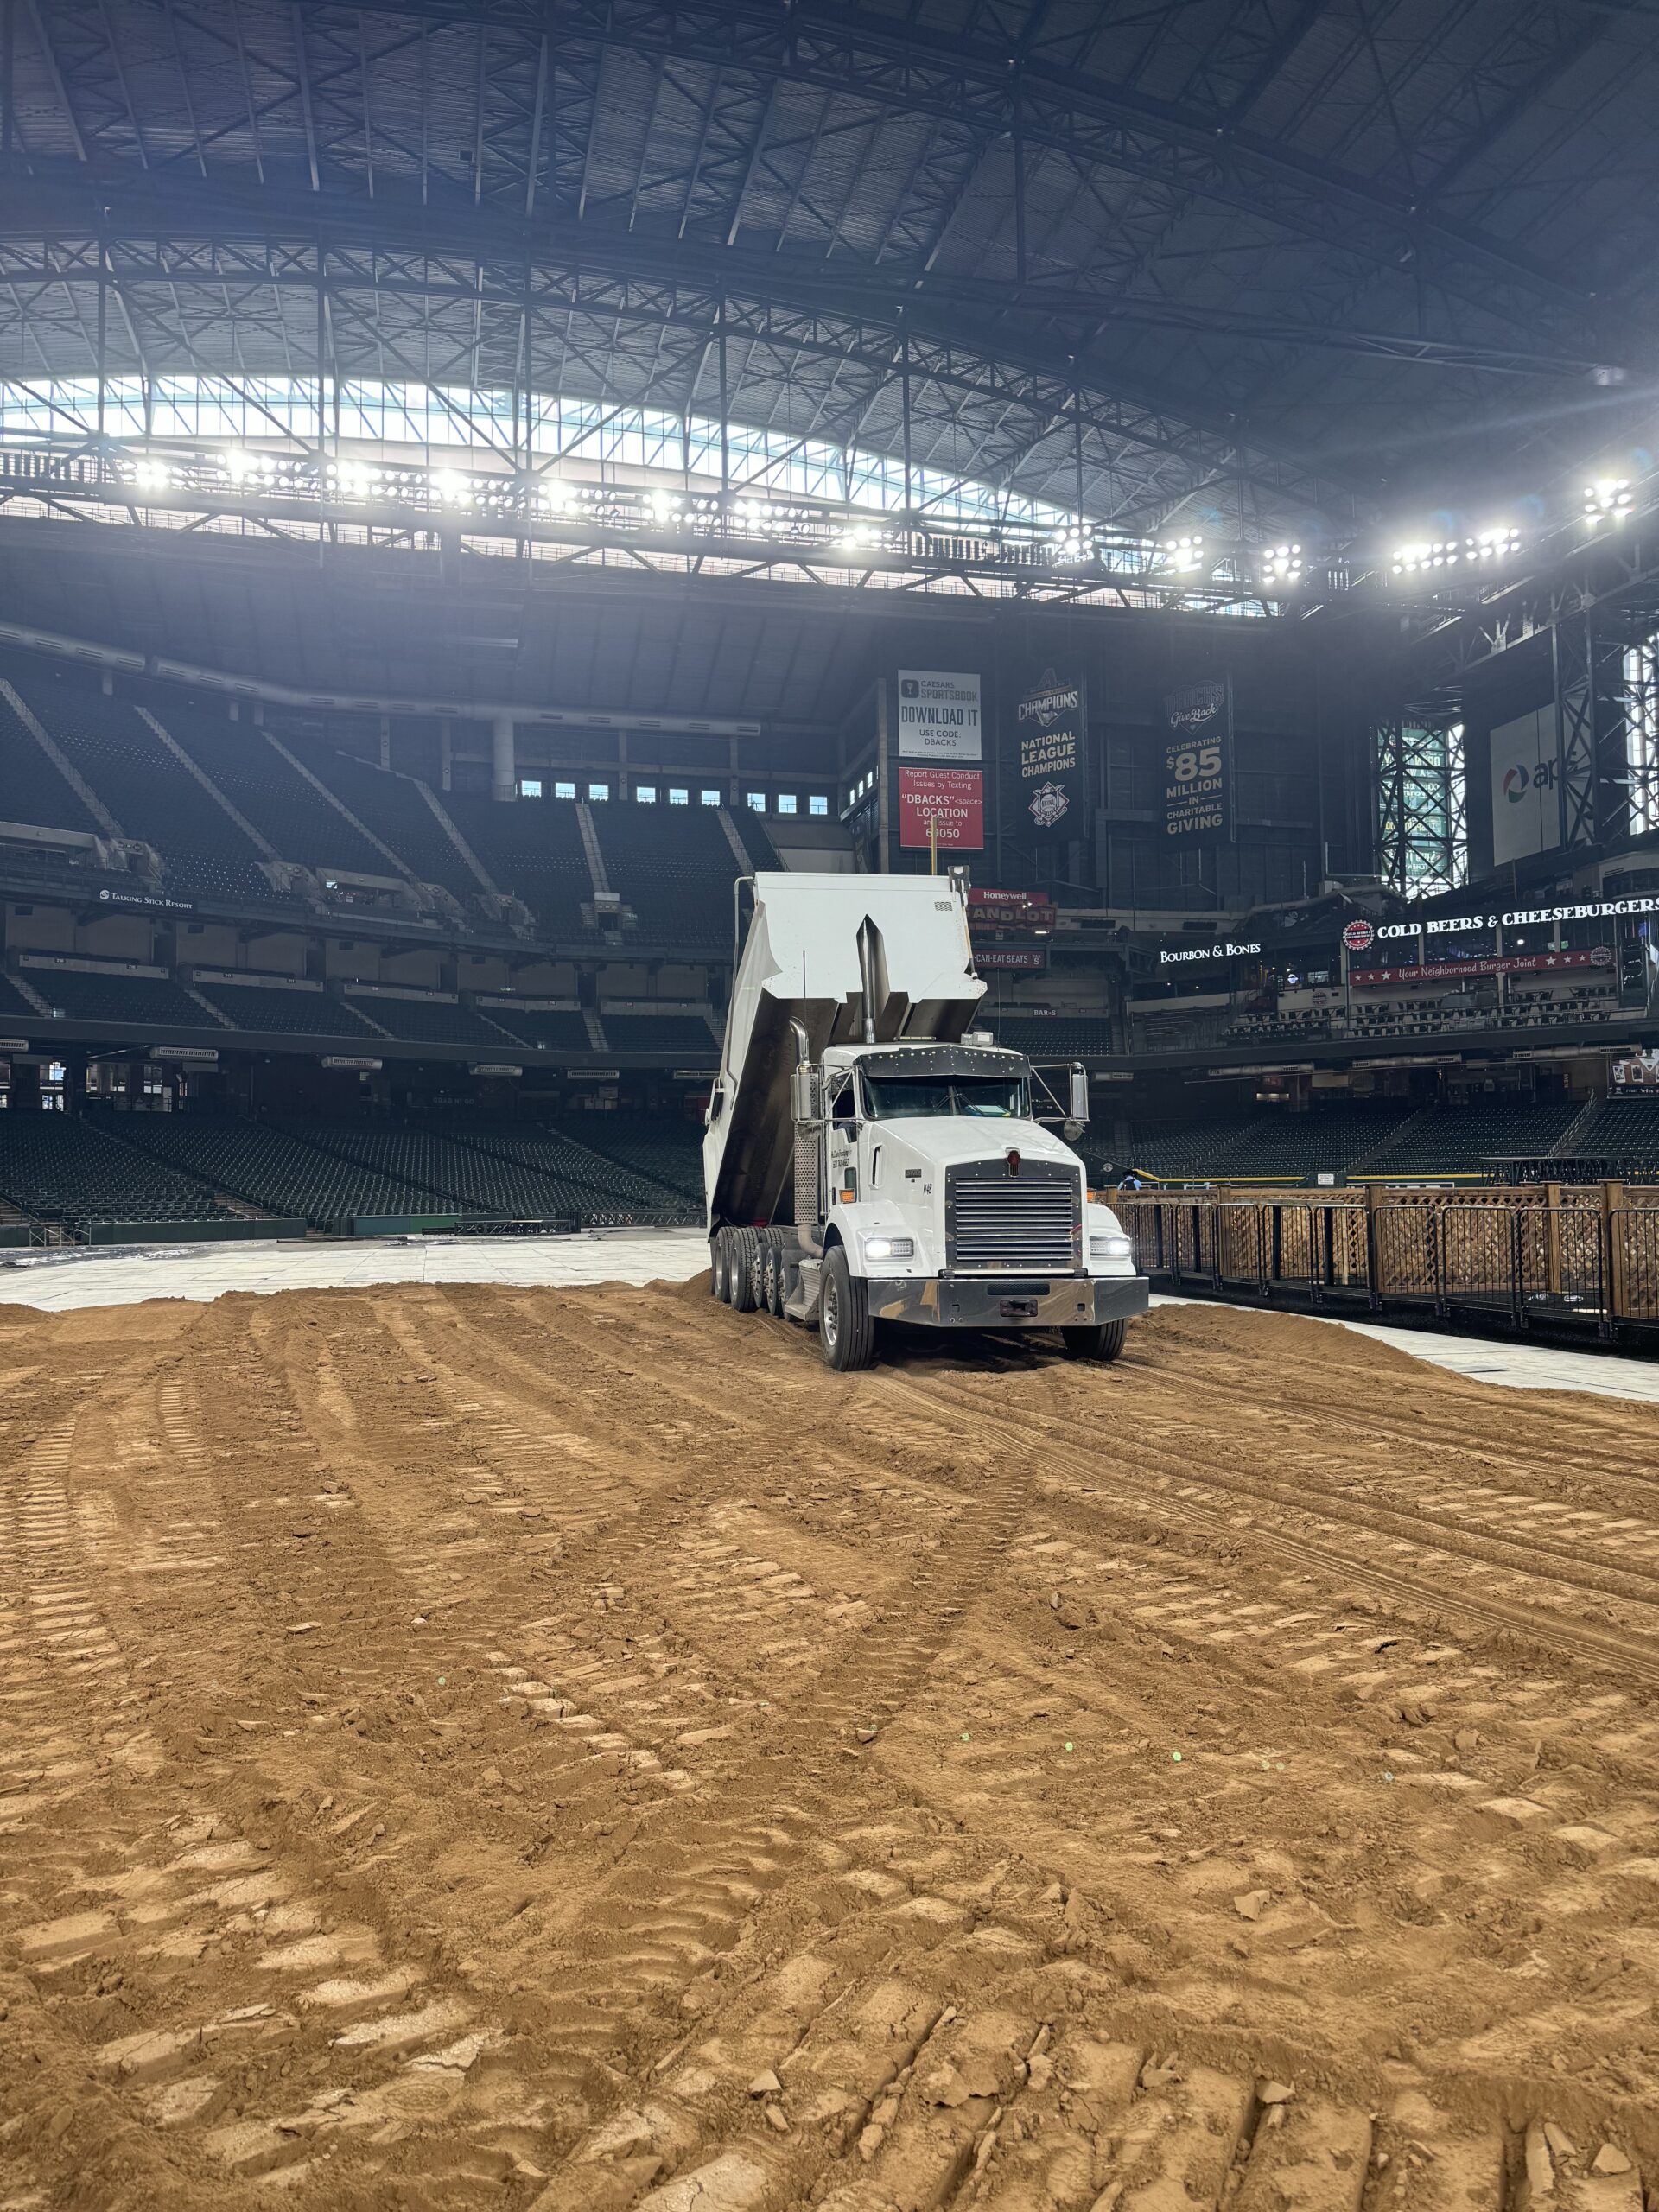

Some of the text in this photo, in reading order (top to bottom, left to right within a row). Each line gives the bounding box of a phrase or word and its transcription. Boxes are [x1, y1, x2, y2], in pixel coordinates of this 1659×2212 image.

[921, 680, 955, 689] CAESARS
[921, 689, 978, 702] SPORTSBOOK
[1019, 691, 1077, 720] CHAMPIONS
[1190, 703, 1217, 722] Back
[901, 706, 978, 726] DOWNLOAD IT
[925, 738, 957, 747] DBACKS
[1021, 731, 1076, 751] NATIONAL
[1166, 735, 1222, 753] CELEBRATING
[1021, 742, 1076, 765] LEAGUE
[1021, 757, 1076, 778] CHAMPIONS
[1166, 747, 1222, 781] $85
[905, 769, 927, 779] Report
[951, 772, 980, 780] Conduct
[937, 780, 945, 789] by
[947, 781, 972, 790] Texting
[1166, 778, 1222, 798] MILLION
[1188, 796, 1199, 805] IN
[916, 807, 968, 817] LOCATION
[1166, 803, 1223, 819] CHARITABLE
[1166, 813, 1223, 835] GIVING
[111, 893, 193, 909] TALKING STICK RESORT
[983, 891, 1027, 900] Honeywell
[973, 907, 1053, 922] ANDLOT
[1377, 923, 1422, 938] COLD
[1426, 916, 1484, 934] BEERS
[1487, 915, 1499, 928] &
[974, 954, 1028, 963] -CAN-EAT SEATS
[1212, 945, 1224, 957] &
[1398, 957, 1536, 980] Your Neighborhood Burger Joint
